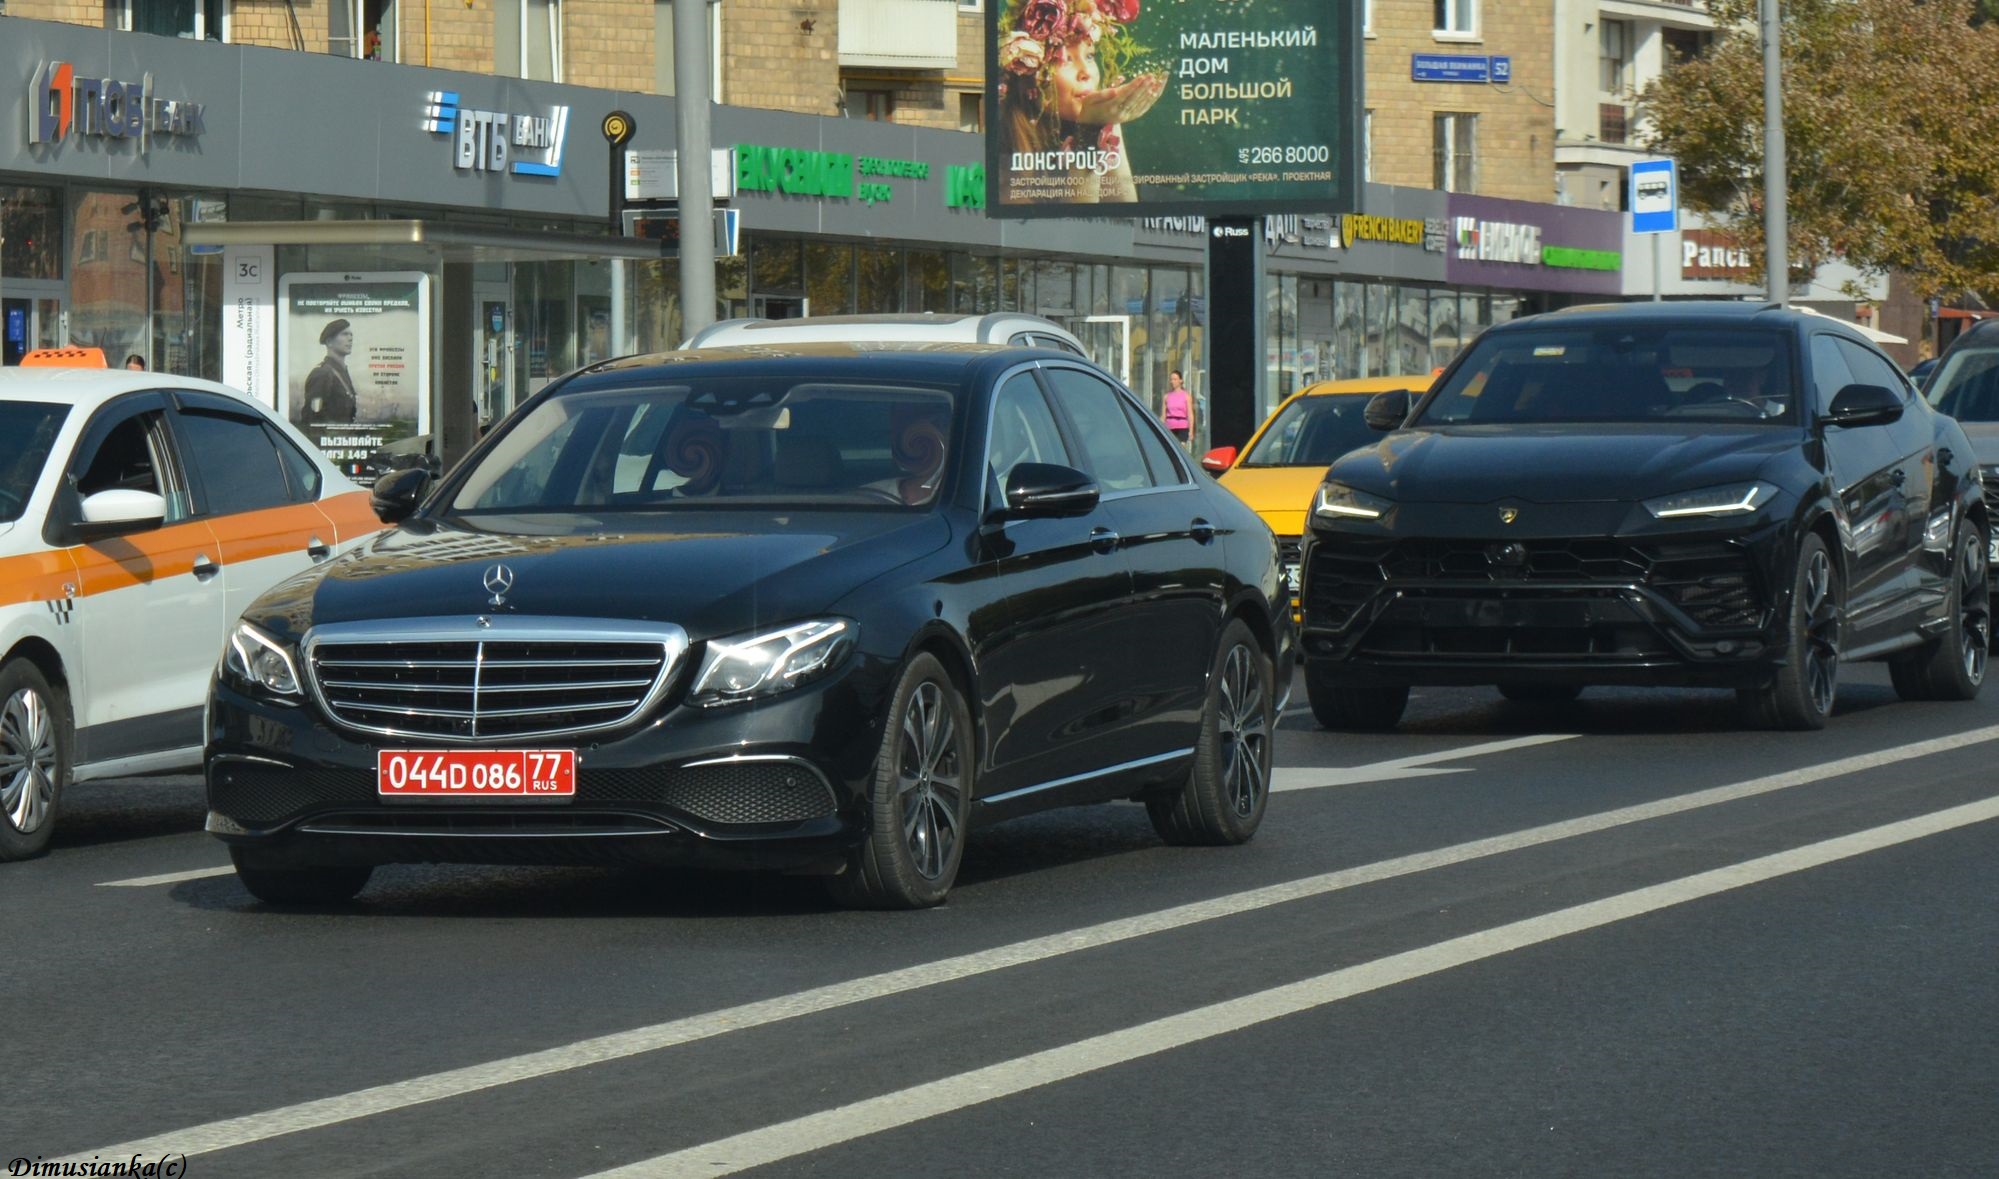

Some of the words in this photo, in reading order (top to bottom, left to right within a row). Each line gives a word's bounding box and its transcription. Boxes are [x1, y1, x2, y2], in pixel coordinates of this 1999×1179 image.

[1180, 25, 1317, 49] МАЛЕНЬКИЙ
[1179, 57, 1229, 78] ДОМ
[1180, 77, 1292, 100] БОЛЬШОЙ
[73, 76, 144, 137] ПСБ
[153, 98, 206, 135] БАНК
[1181, 108, 1239, 125] ПАРК
[457, 109, 508, 171] ВТБ
[512, 114, 554, 147] БАНК
[1010, 147, 1097, 171] ДОНСТРОЙ
[1238, 148, 1249, 164] 495
[1251, 147, 1283, 164] 266
[1285, 146, 1329, 163] 8000
[1010, 176, 1066, 187] ЗАСТРОЙЩИК
[1066, 177, 1085, 186] ООО
[1191, 173, 1247, 184] ЗАСТРОЙЩИК
[1249, 173, 1280, 182] «РЕКА».
[1282, 172, 1331, 181] ПРОЕКТНАЯ
[1010, 189, 1063, 199] ДЕКЛАРАЦИЯ
[1064, 189, 1076, 198] НА
[1224, 227, 1249, 236] Russ
[1264, 214, 1298, 244] ДАШ
[1353, 215, 1390, 241] FRENCH
[1391, 218, 1425, 245] BAKERY
[237, 297, 245, 329] Метро
[245, 297, 253, 359] (радиальная)
[320, 435, 383, 447] ВЫЗЫВАЙТЕ
[347, 449, 367, 460] 149
[528, 754, 561, 780] 77
[532, 780, 558, 791] RUS
